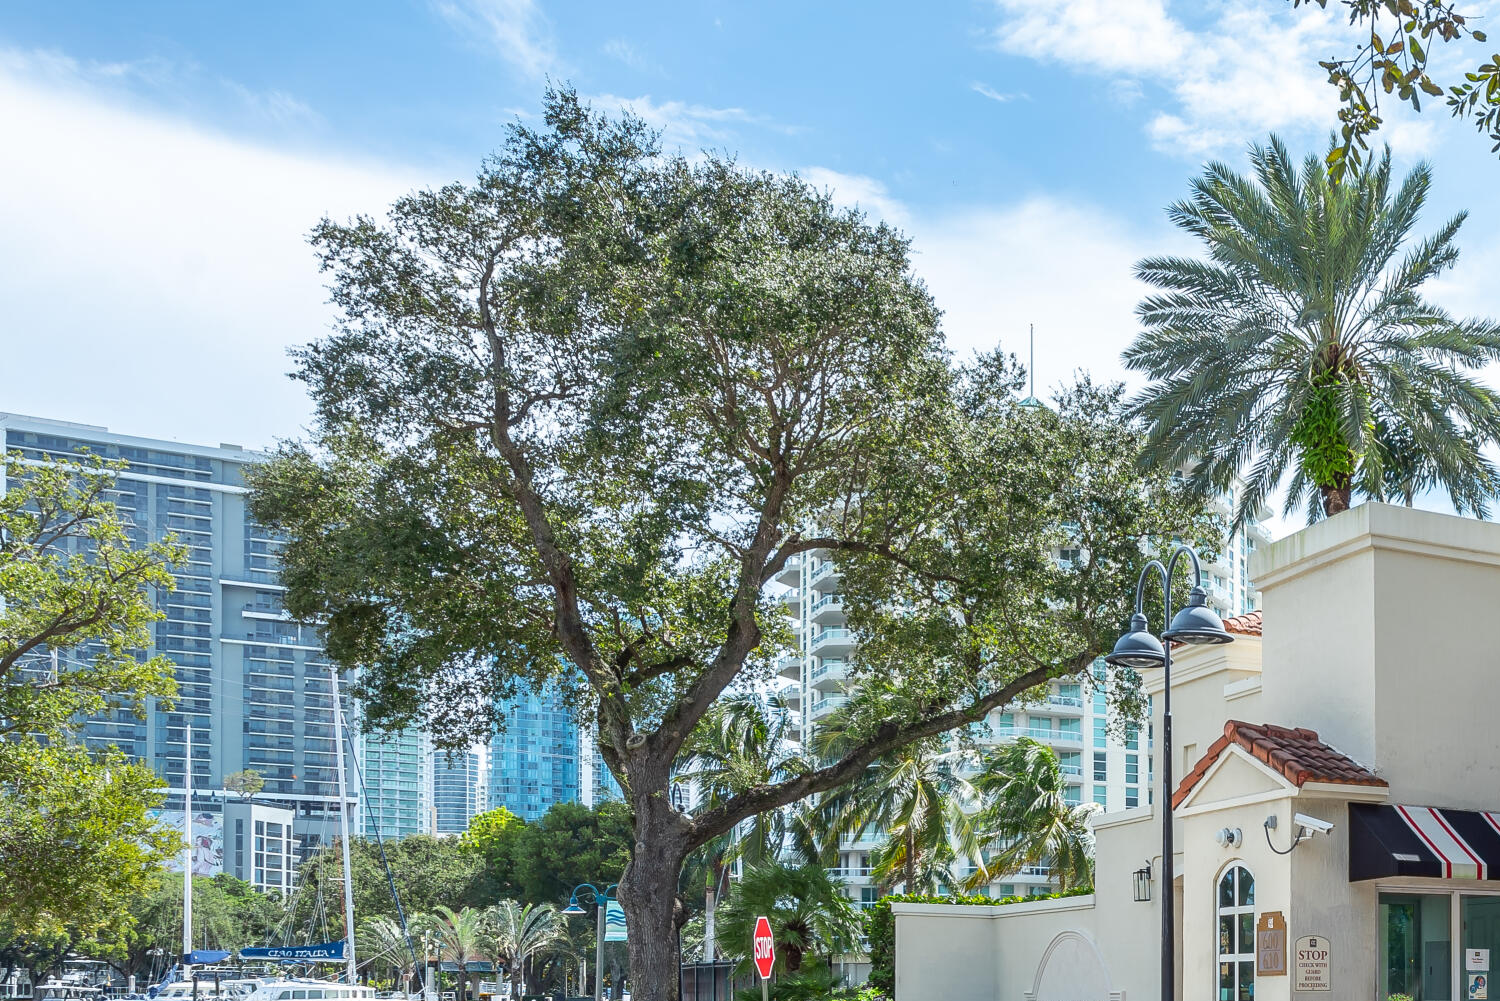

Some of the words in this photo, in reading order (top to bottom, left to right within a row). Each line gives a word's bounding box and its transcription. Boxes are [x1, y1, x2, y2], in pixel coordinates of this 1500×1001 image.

[294, 949, 329, 957] ITALIA
[756, 936, 772, 960] STOP
[1298, 950, 1328, 960] STOP
[1263, 951, 1279, 969] 610
